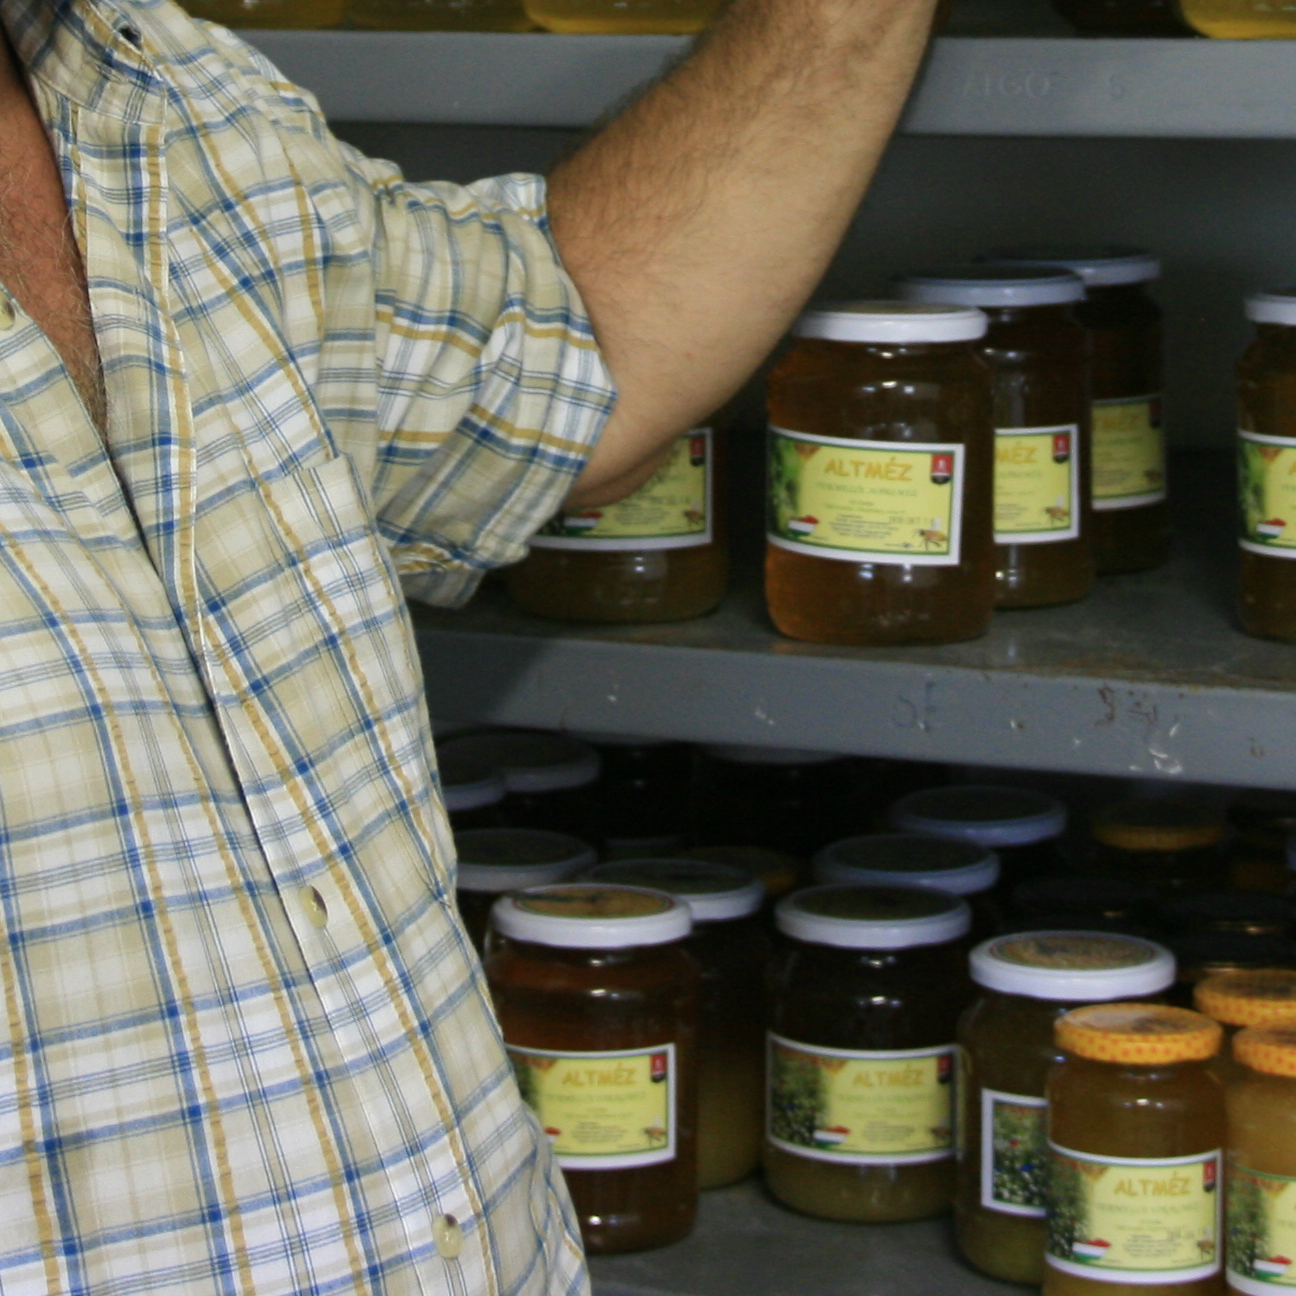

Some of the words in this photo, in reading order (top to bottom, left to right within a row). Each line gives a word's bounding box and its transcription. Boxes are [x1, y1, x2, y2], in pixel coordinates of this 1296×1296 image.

[824, 456, 913, 482] ALTMÉZ
[562, 1061, 637, 1086] ALTMÉZ
[1113, 1171, 1192, 1197] ALTMÉZ
